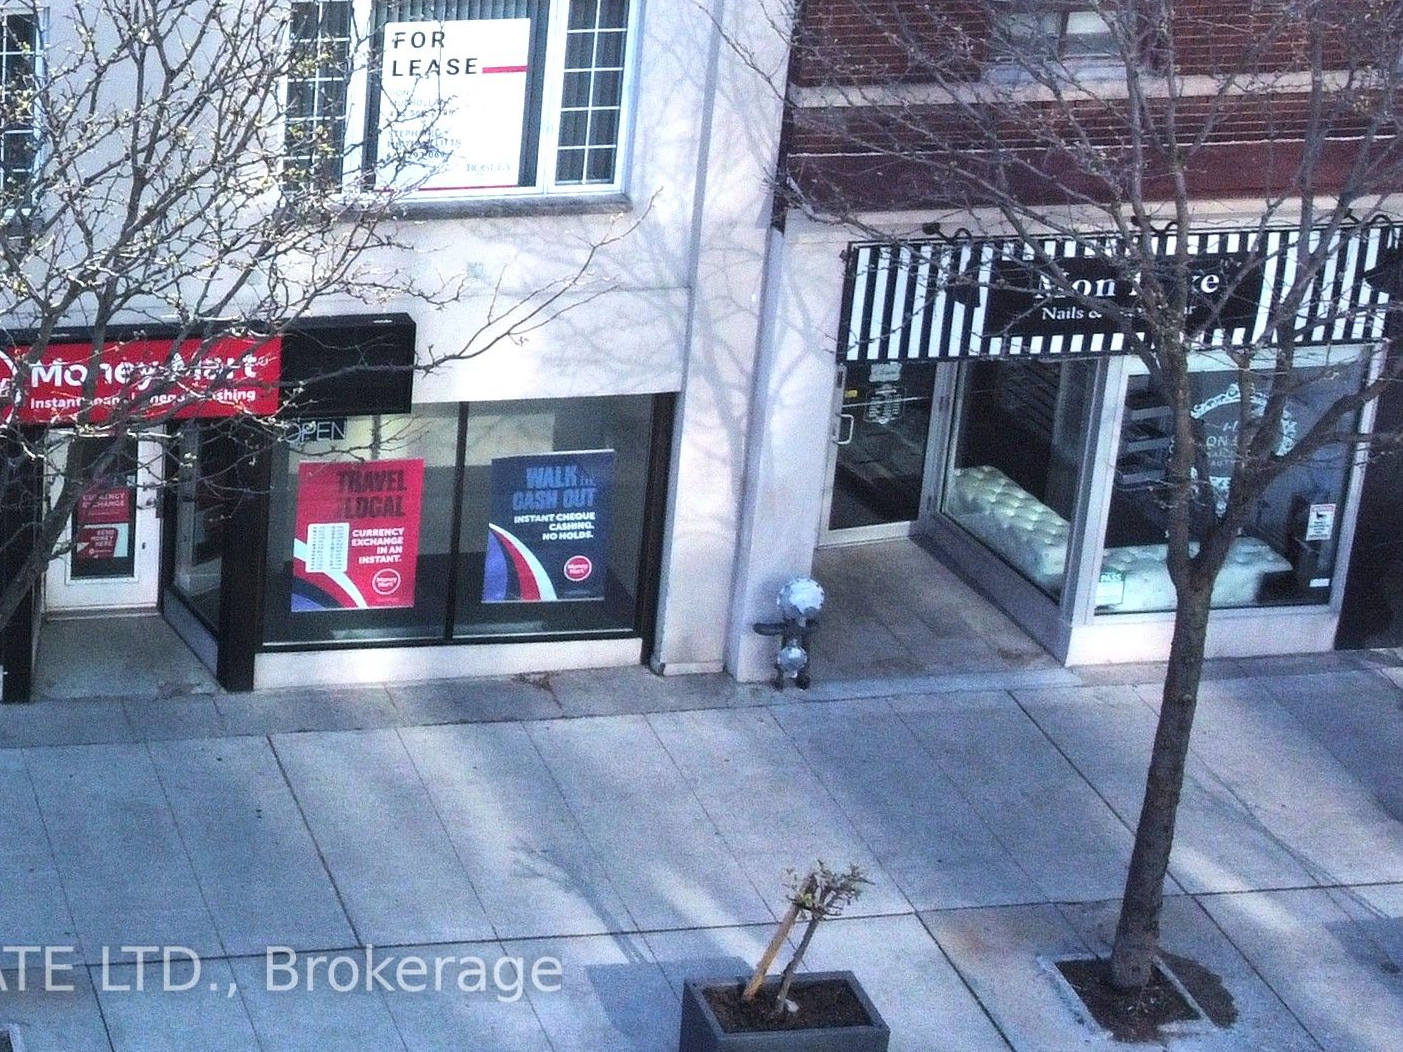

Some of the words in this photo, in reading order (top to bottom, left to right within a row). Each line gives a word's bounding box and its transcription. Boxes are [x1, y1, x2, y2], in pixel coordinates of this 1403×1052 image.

[393, 31, 446, 49] FOR
[392, 58, 478, 77] LEASE
[1042, 306, 1084, 320] Nails
[284, 421, 347, 444] OPEN
[337, 469, 407, 493] TRAVEL
[526, 465, 578, 489] WALK
[512, 489, 558, 511] CASH
[563, 487, 597, 508] OUT
[342, 496, 405, 519] LOCAL
[514, 513, 555, 524] INSTANT
[555, 512, 596, 521] CHEQUE
[351, 528, 404, 538] CURRENCY
[549, 522, 594, 531] CASHING.
[351, 537, 404, 547] EXCHANGE
[542, 532, 557, 540] NO
[559, 531, 594, 540] HOLDS.
[377, 546, 387, 554] IN
[388, 545, 403, 553] AN
[358, 554, 402, 564] INSTANT.
